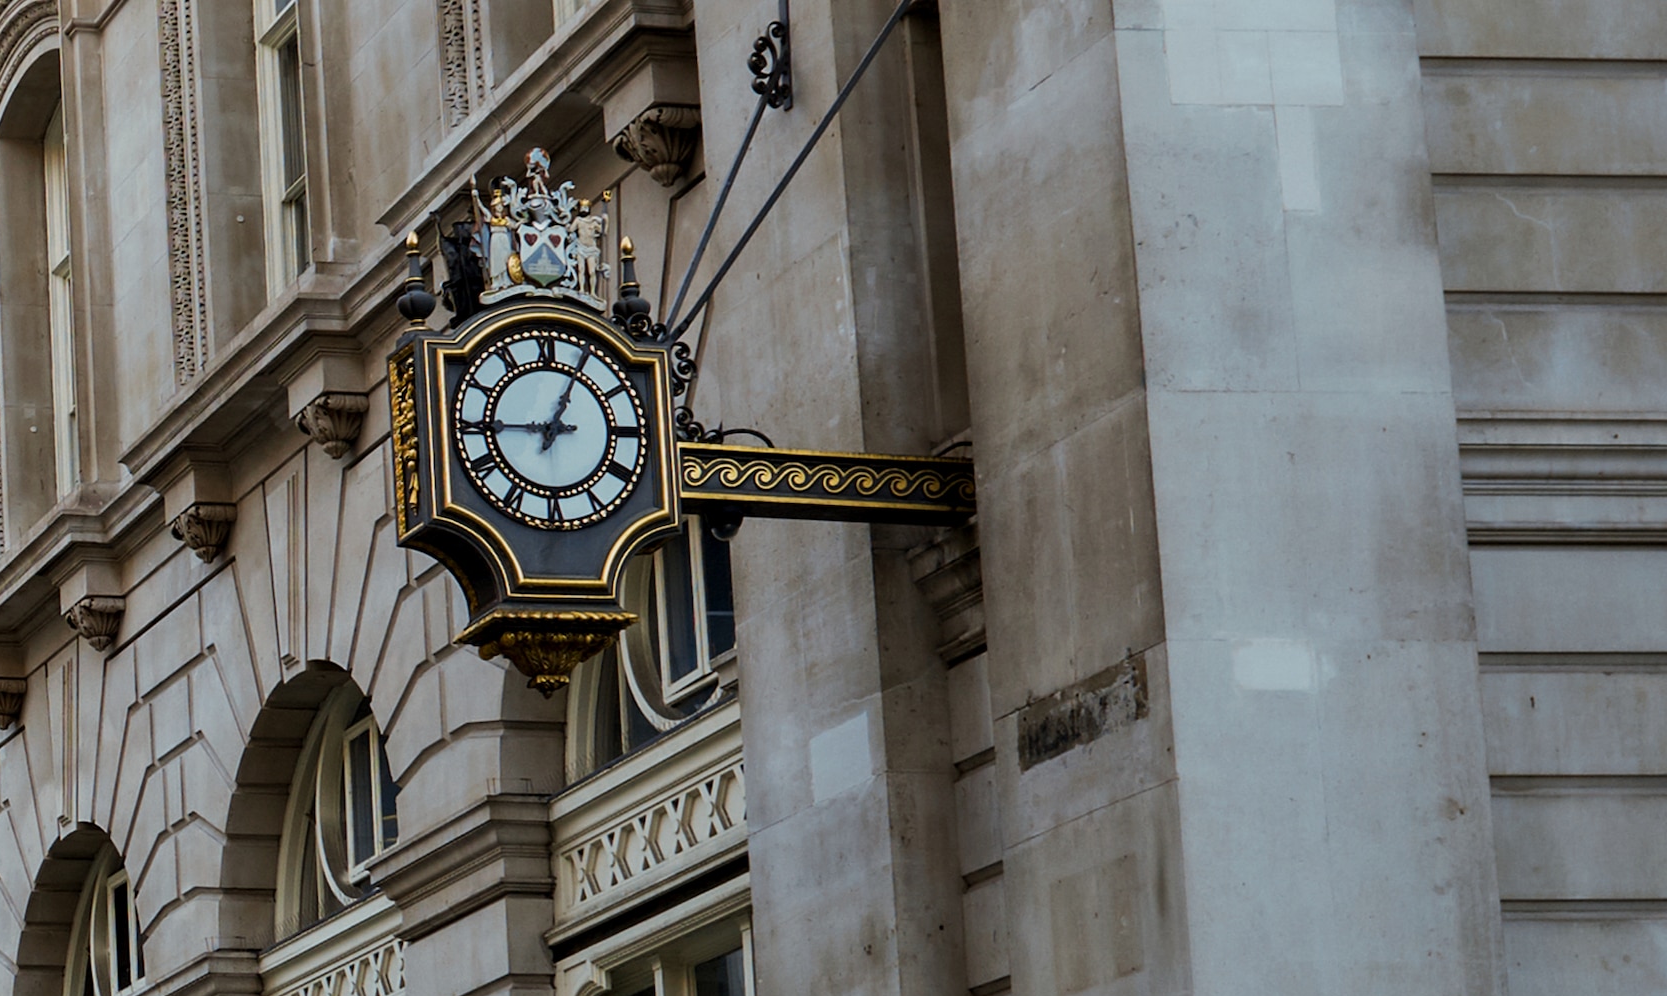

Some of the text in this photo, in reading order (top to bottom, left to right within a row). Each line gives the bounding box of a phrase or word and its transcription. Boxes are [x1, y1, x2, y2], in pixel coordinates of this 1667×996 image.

[493, 345, 518, 372] XI
[536, 338, 555, 364] XII
[466, 377, 492, 398] X
[604, 384, 626, 400] II
[460, 418, 486, 435] IX
[614, 425, 640, 439] III
[503, 483, 525, 513] VII
[547, 495, 565, 520] VI
[587, 489, 607, 512] V
